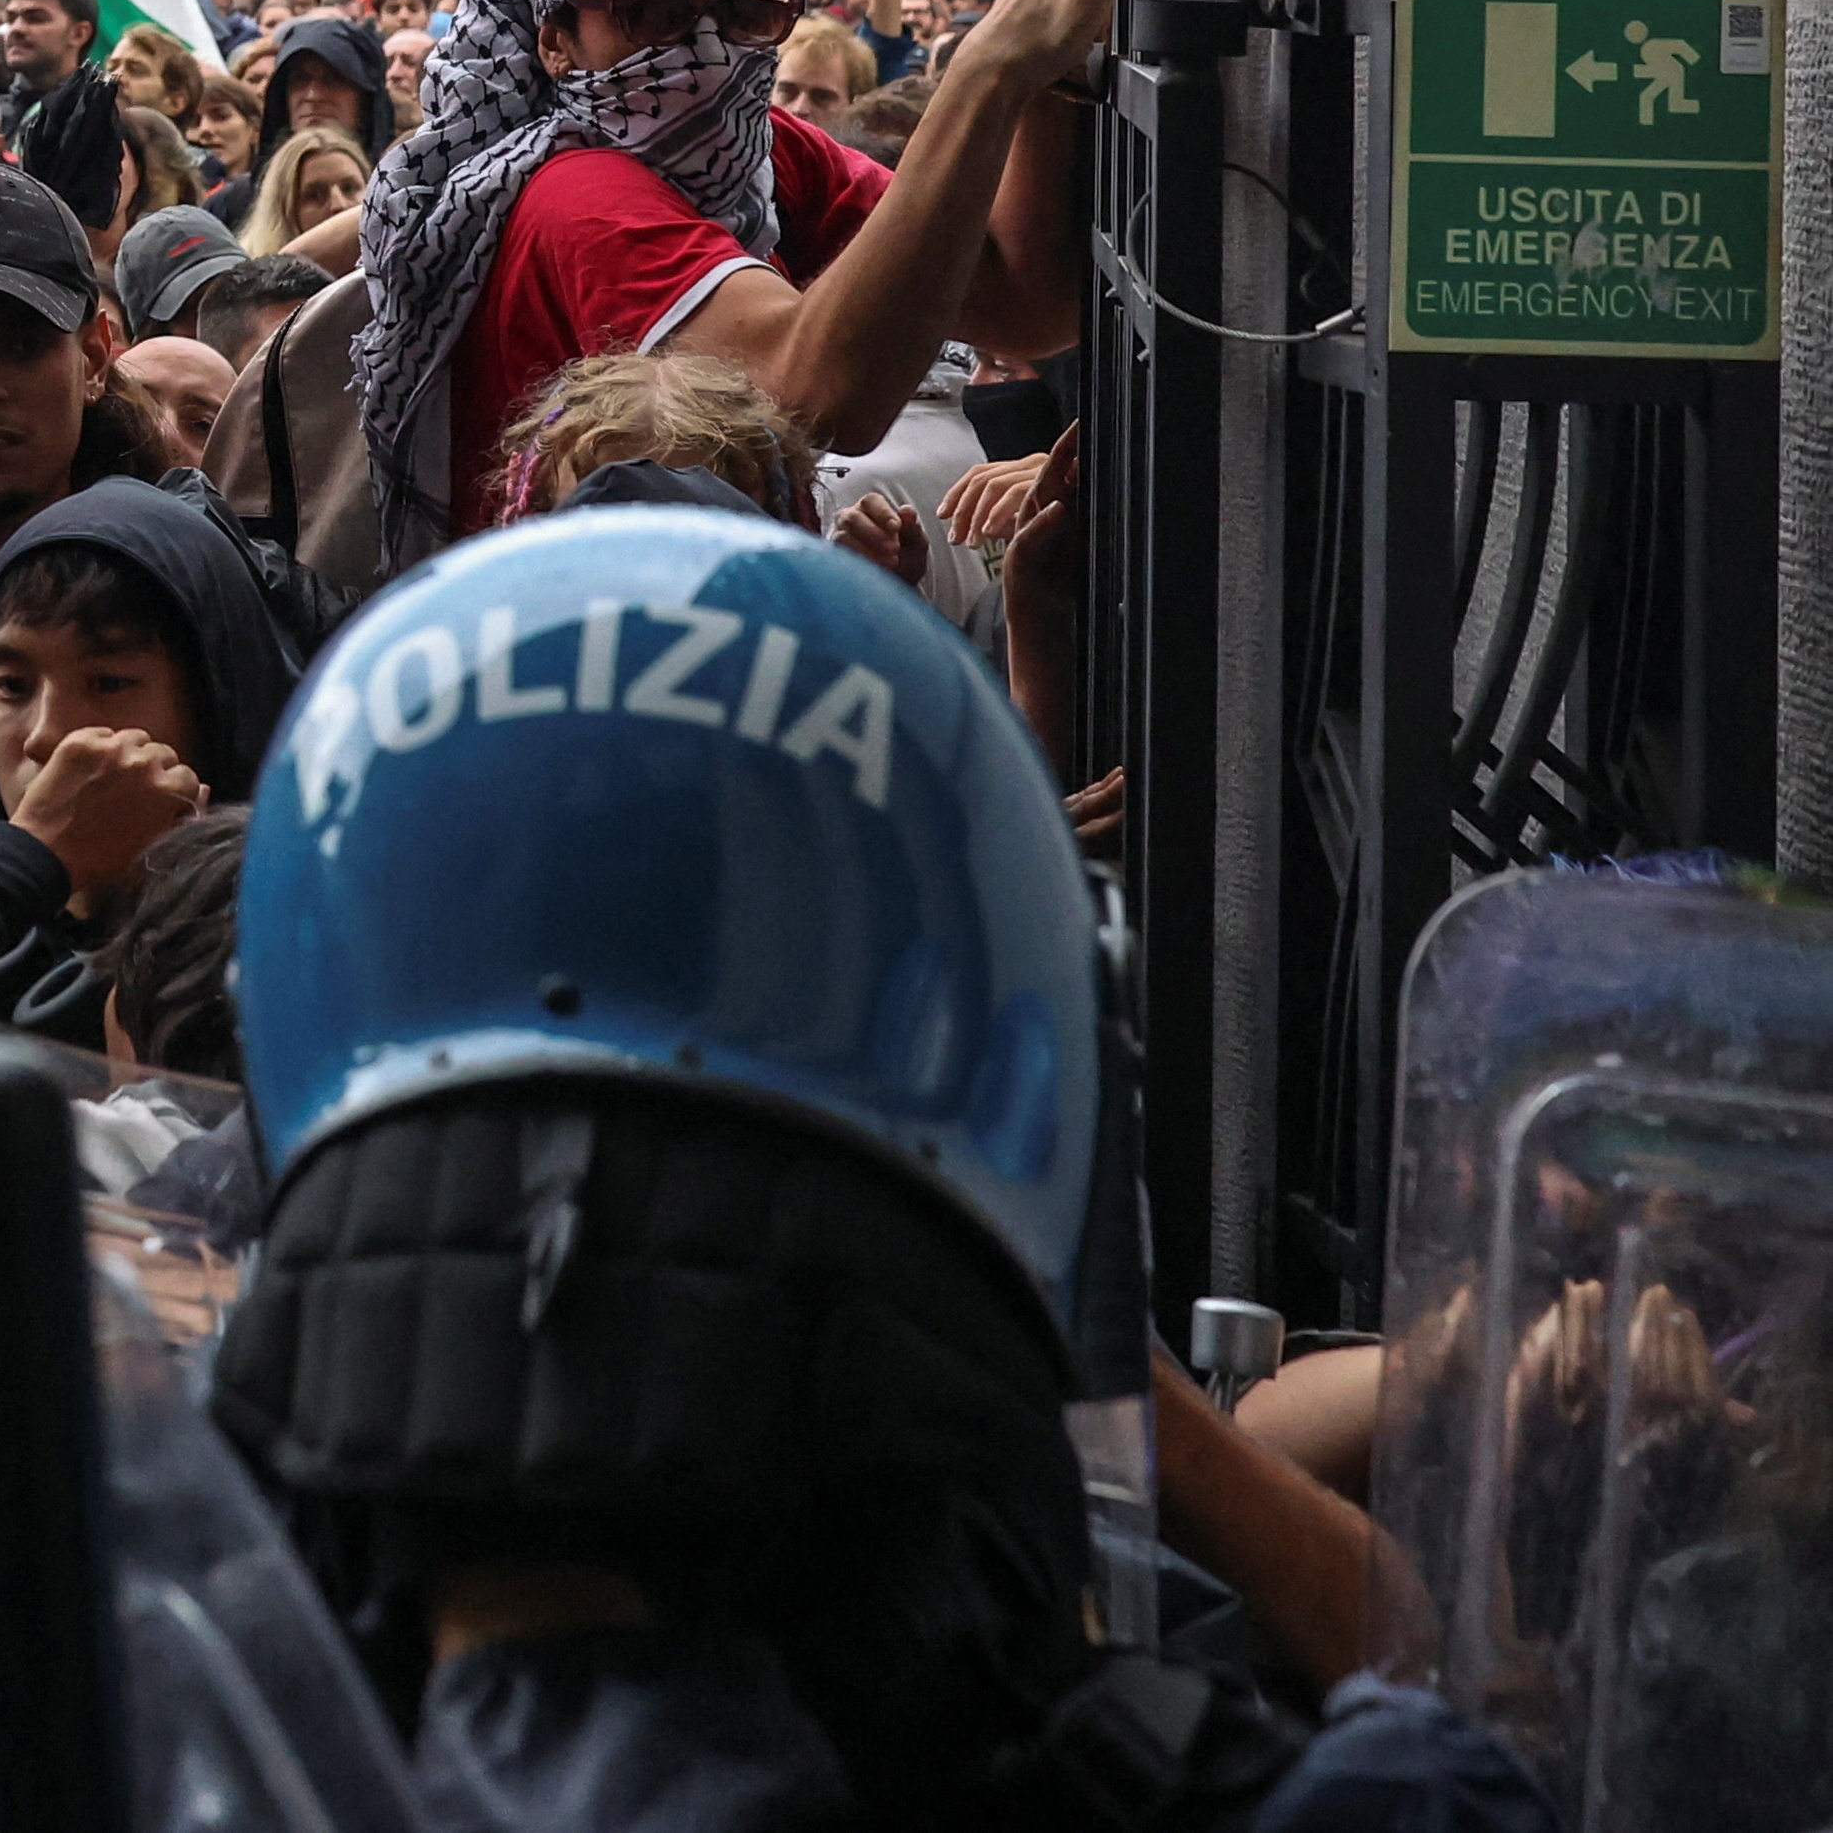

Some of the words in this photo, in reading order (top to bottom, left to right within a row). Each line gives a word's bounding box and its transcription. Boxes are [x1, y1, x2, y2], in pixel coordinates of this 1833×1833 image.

[1479, 187, 1643, 224] USCITA
[1660, 192, 1701, 226] DI
[1445, 229, 1732, 269] EMERGENZA
[1415, 280, 1656, 319] EMERGENCY
[1674, 286, 1758, 323] EXIT
[290, 597, 894, 828] POLIZIA
